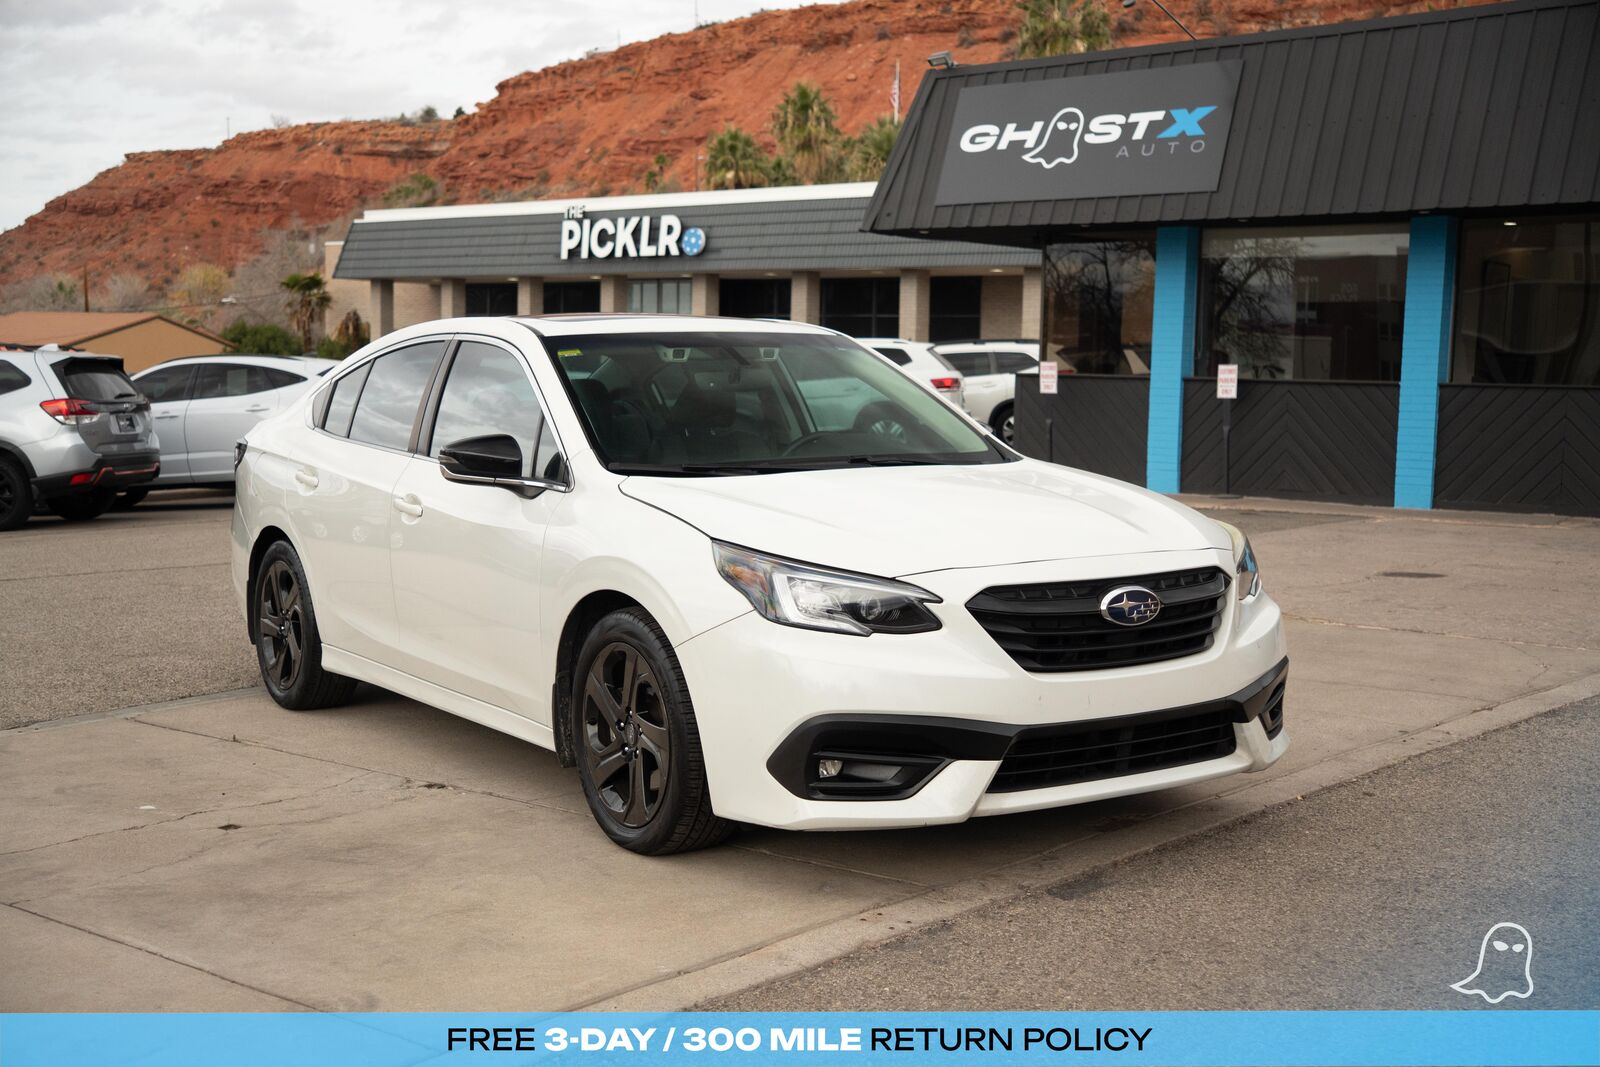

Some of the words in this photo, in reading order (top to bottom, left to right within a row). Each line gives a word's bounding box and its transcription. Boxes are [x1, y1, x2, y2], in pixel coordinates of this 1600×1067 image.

[1115, 139, 1206, 158] AUTO
[563, 204, 586, 219] THE
[560, 214, 682, 260] PICKLR
